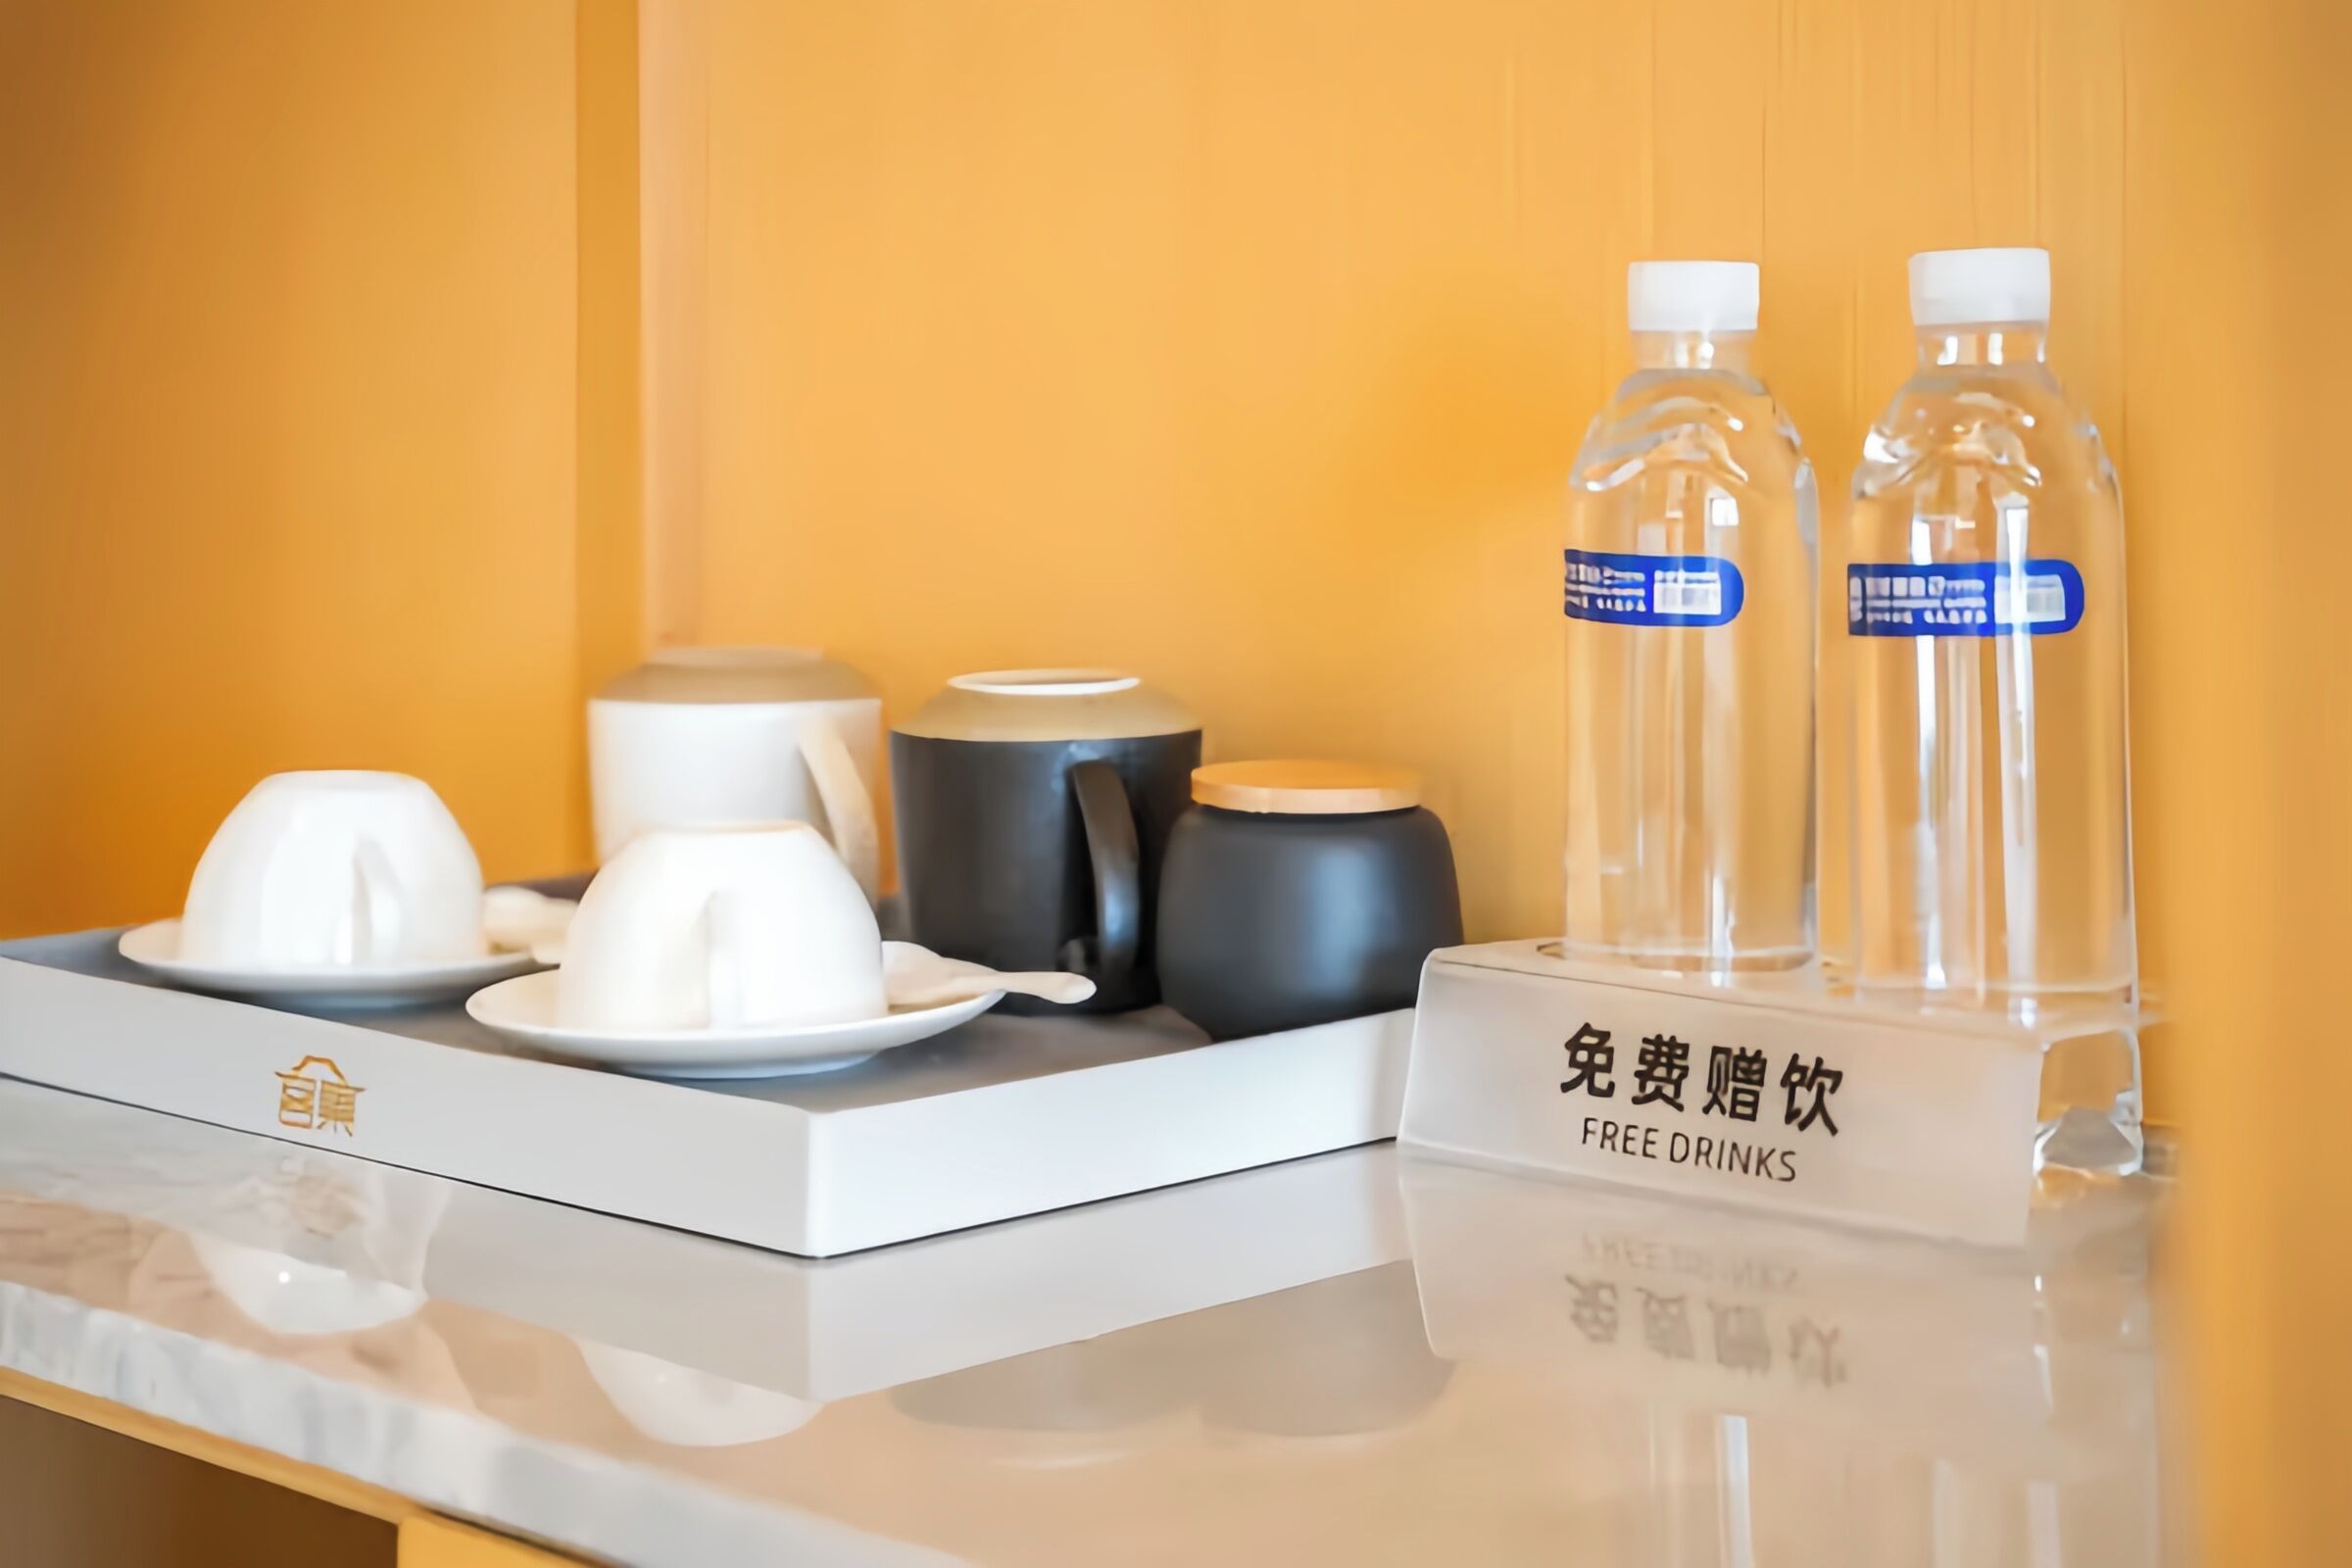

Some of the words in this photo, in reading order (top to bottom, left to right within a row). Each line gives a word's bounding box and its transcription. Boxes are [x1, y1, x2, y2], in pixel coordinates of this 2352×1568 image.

[1559, 1021, 1843, 1138] 免费赠饮
[1581, 1116, 1659, 1159] FREE
[1669, 1131, 1796, 1183] DRINKS
